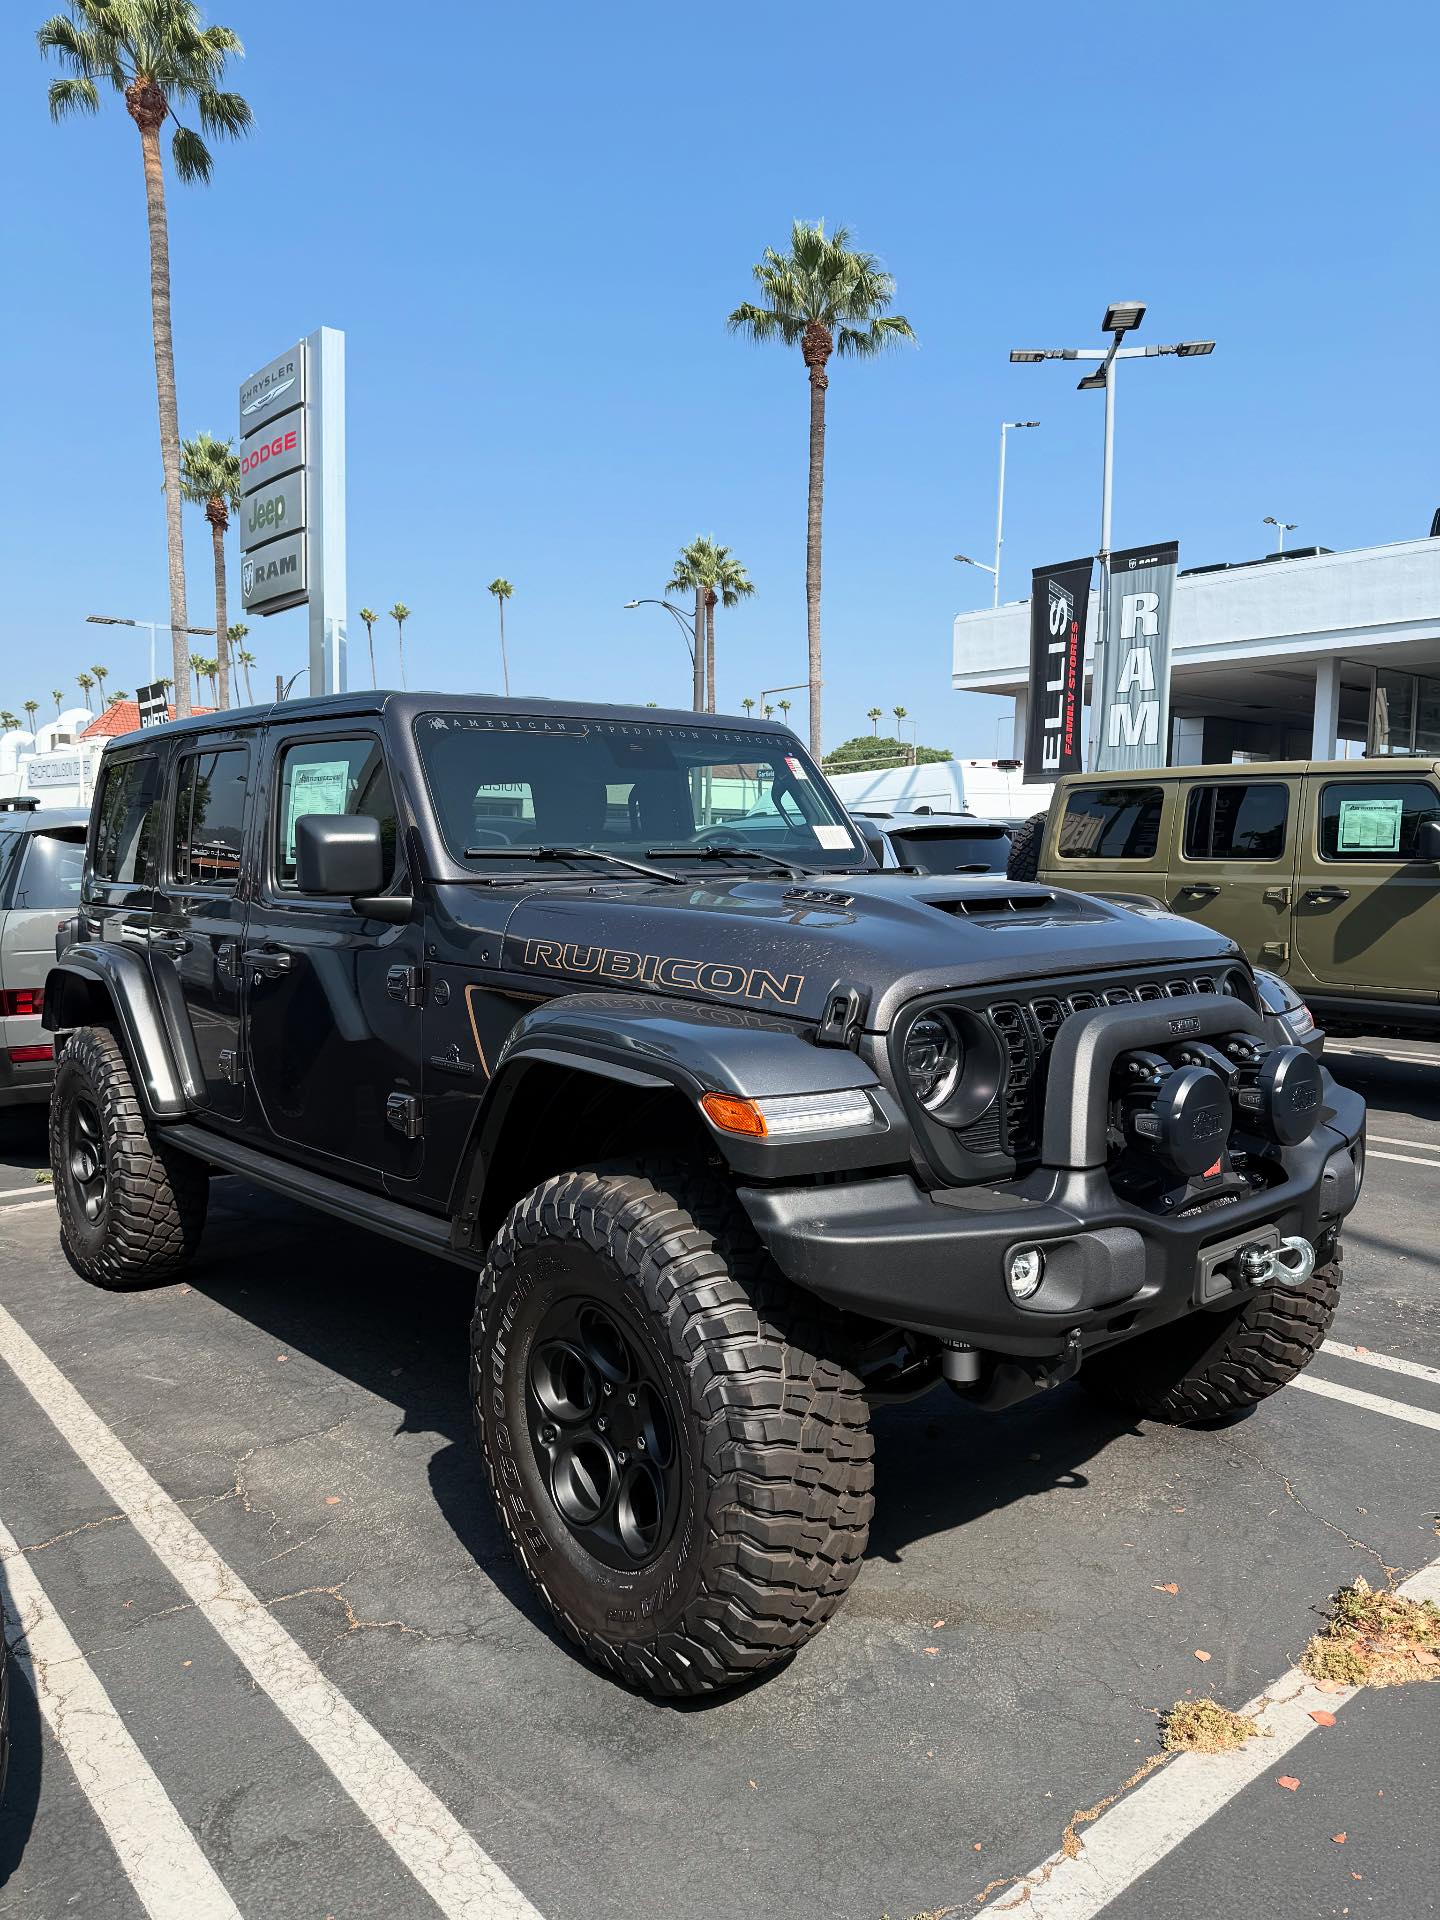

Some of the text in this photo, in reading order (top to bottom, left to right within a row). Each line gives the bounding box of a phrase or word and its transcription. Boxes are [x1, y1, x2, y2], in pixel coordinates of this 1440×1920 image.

[242, 362, 294, 404] CHRYSLER
[242, 431, 297, 476] DODGE
[249, 494, 286, 533] Jeep
[255, 554, 297, 584] RAM
[1042, 597, 1068, 769] ELLIS
[1064, 621, 1079, 756] FAMILY STORES
[1108, 592, 1160, 748] RAM
[141, 710, 170, 729] PARTS
[453, 719, 566, 731] AMERICAN
[581, 724, 700, 739] EXPEDITION
[524, 938, 805, 1005] RUBICON
